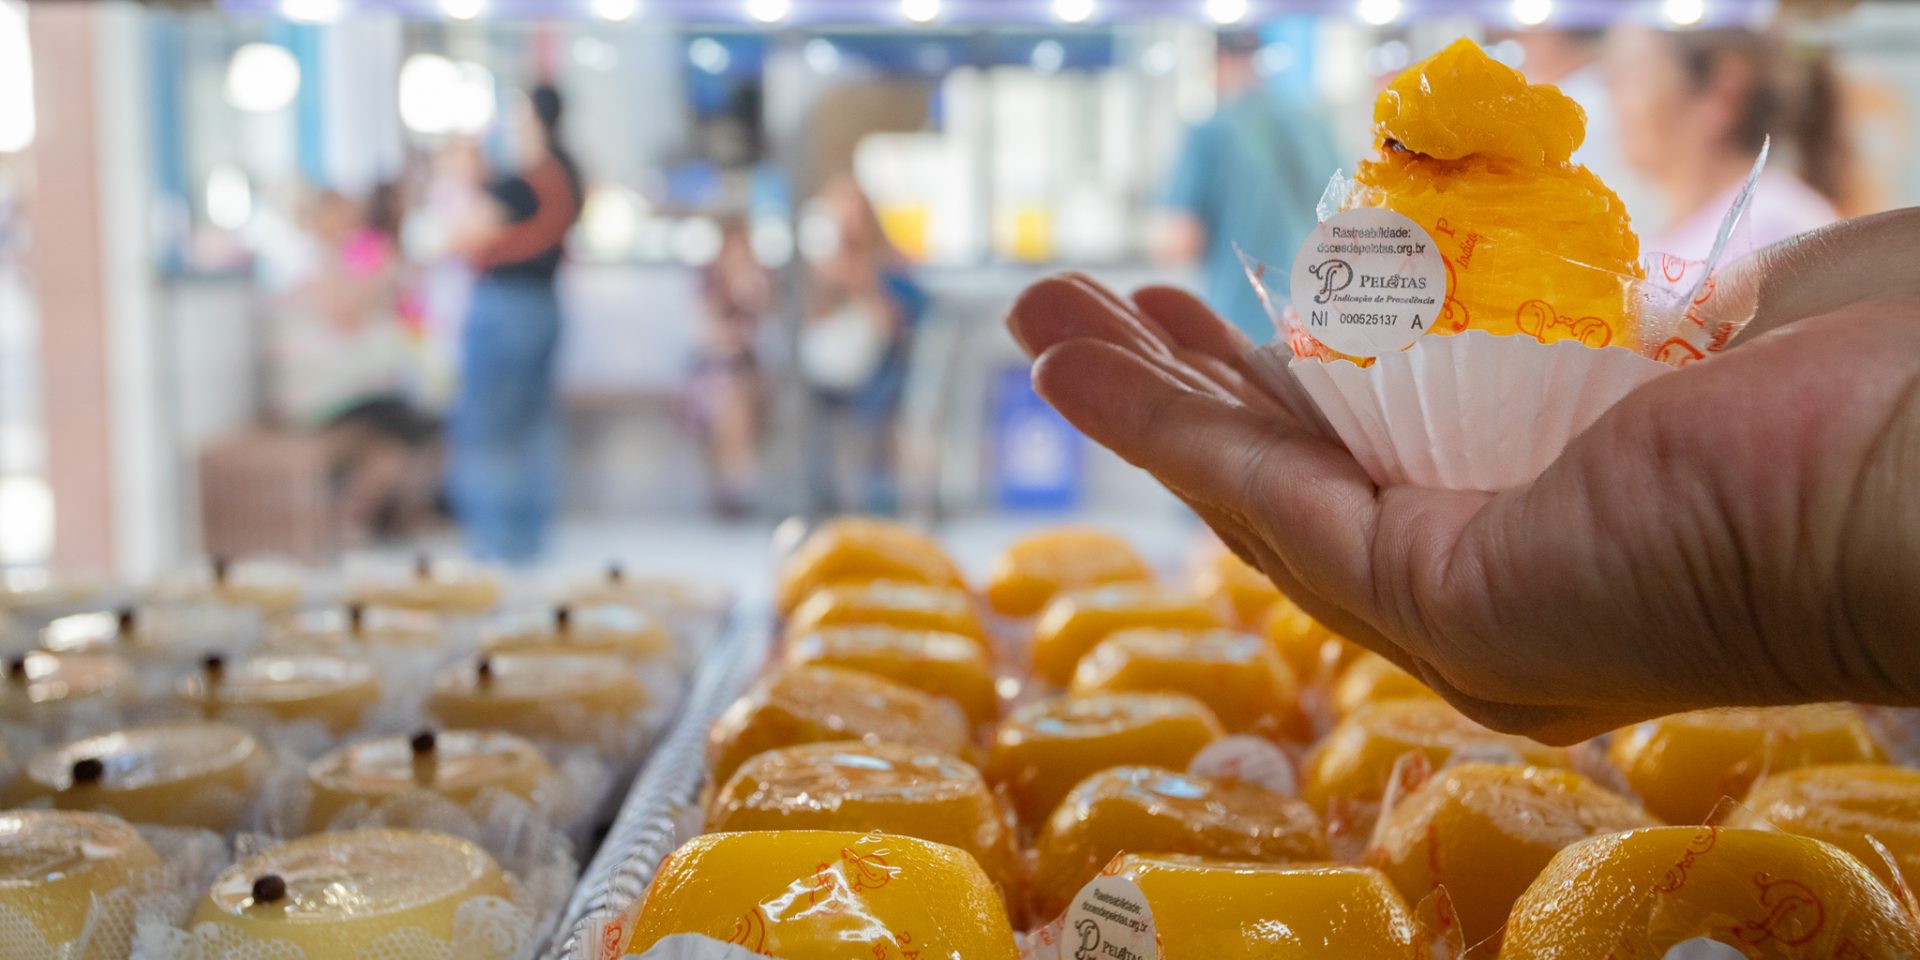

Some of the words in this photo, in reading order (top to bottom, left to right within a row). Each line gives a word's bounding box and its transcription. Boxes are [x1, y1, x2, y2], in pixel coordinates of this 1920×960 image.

[1317, 243, 1426, 256] docesdepelotas.org.br
[1333, 293, 1373, 304] Indicação
[1374, 295, 1385, 303] de
[1385, 294, 1435, 305] Procedência
[1311, 310, 1328, 327] NI
[1340, 313, 1398, 325] 000525137
[1410, 314, 1423, 330] A
